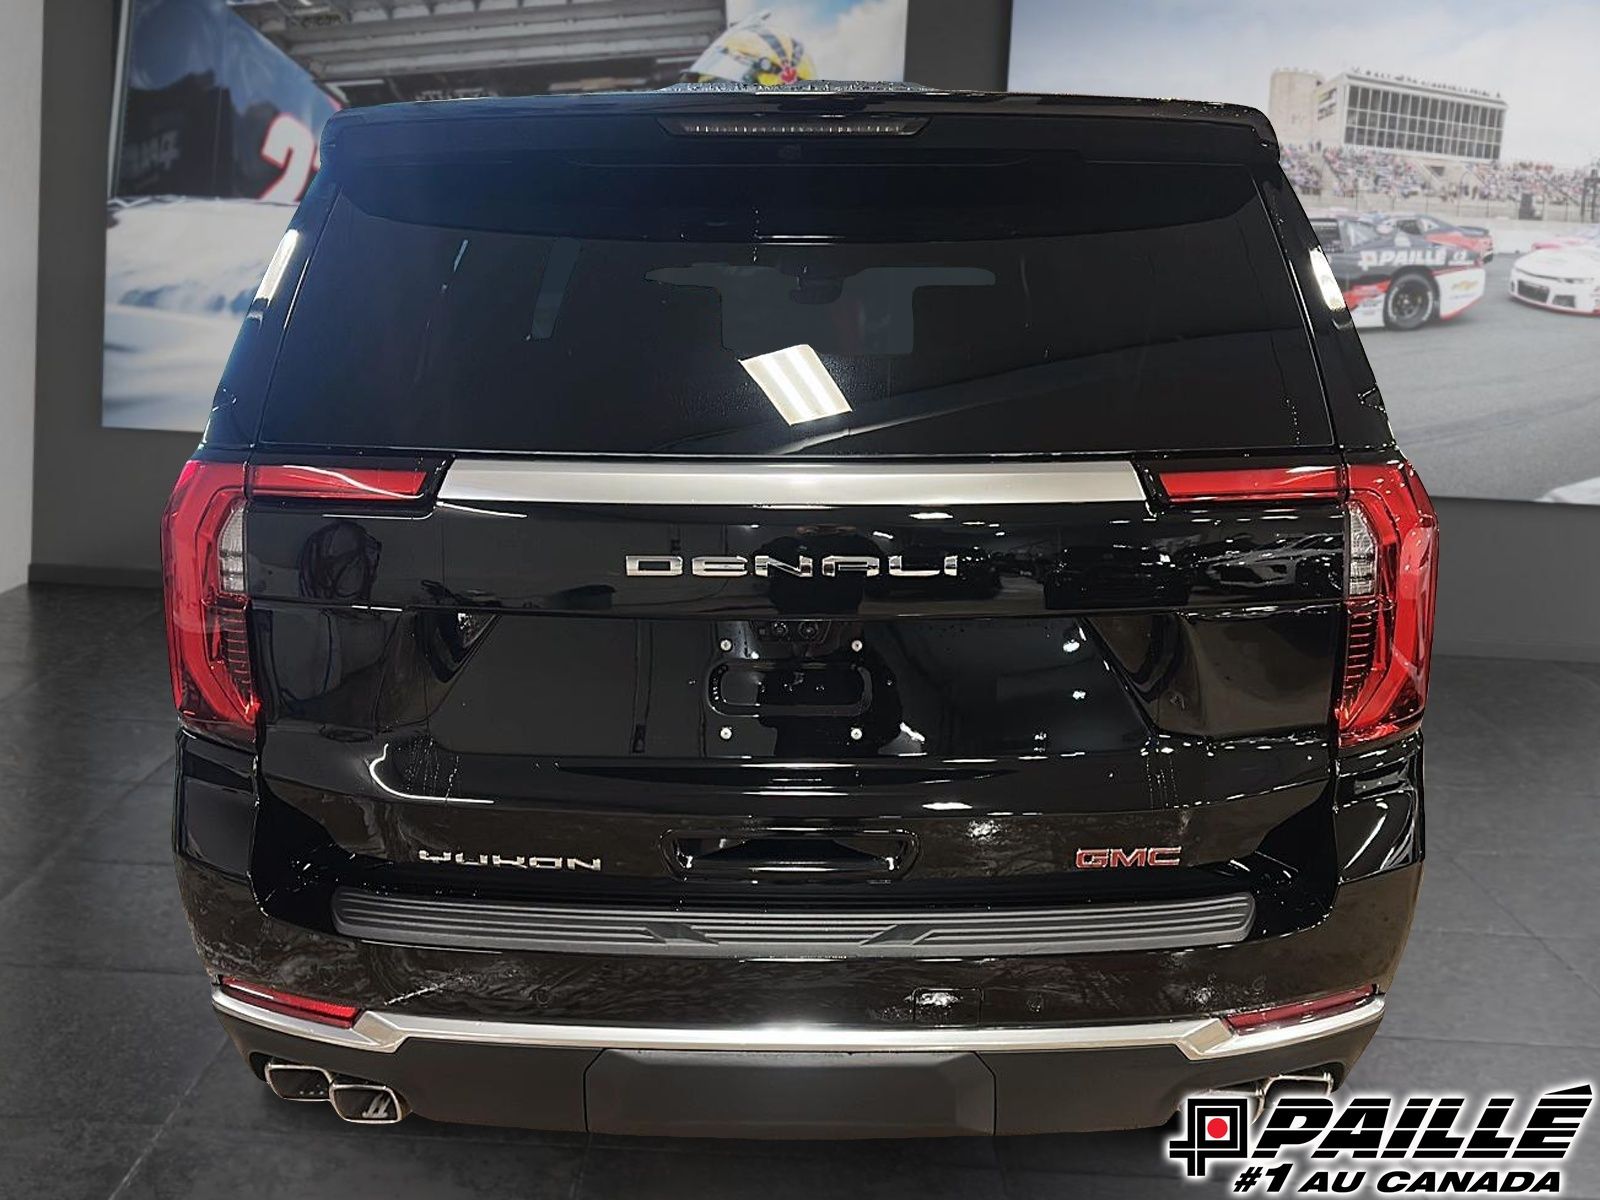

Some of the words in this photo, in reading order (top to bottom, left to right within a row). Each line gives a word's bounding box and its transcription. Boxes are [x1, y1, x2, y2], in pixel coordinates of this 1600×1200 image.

[625, 555, 958, 577] DENALI
[419, 849, 601, 871] YUKON
[1075, 846, 1182, 868] GMC
